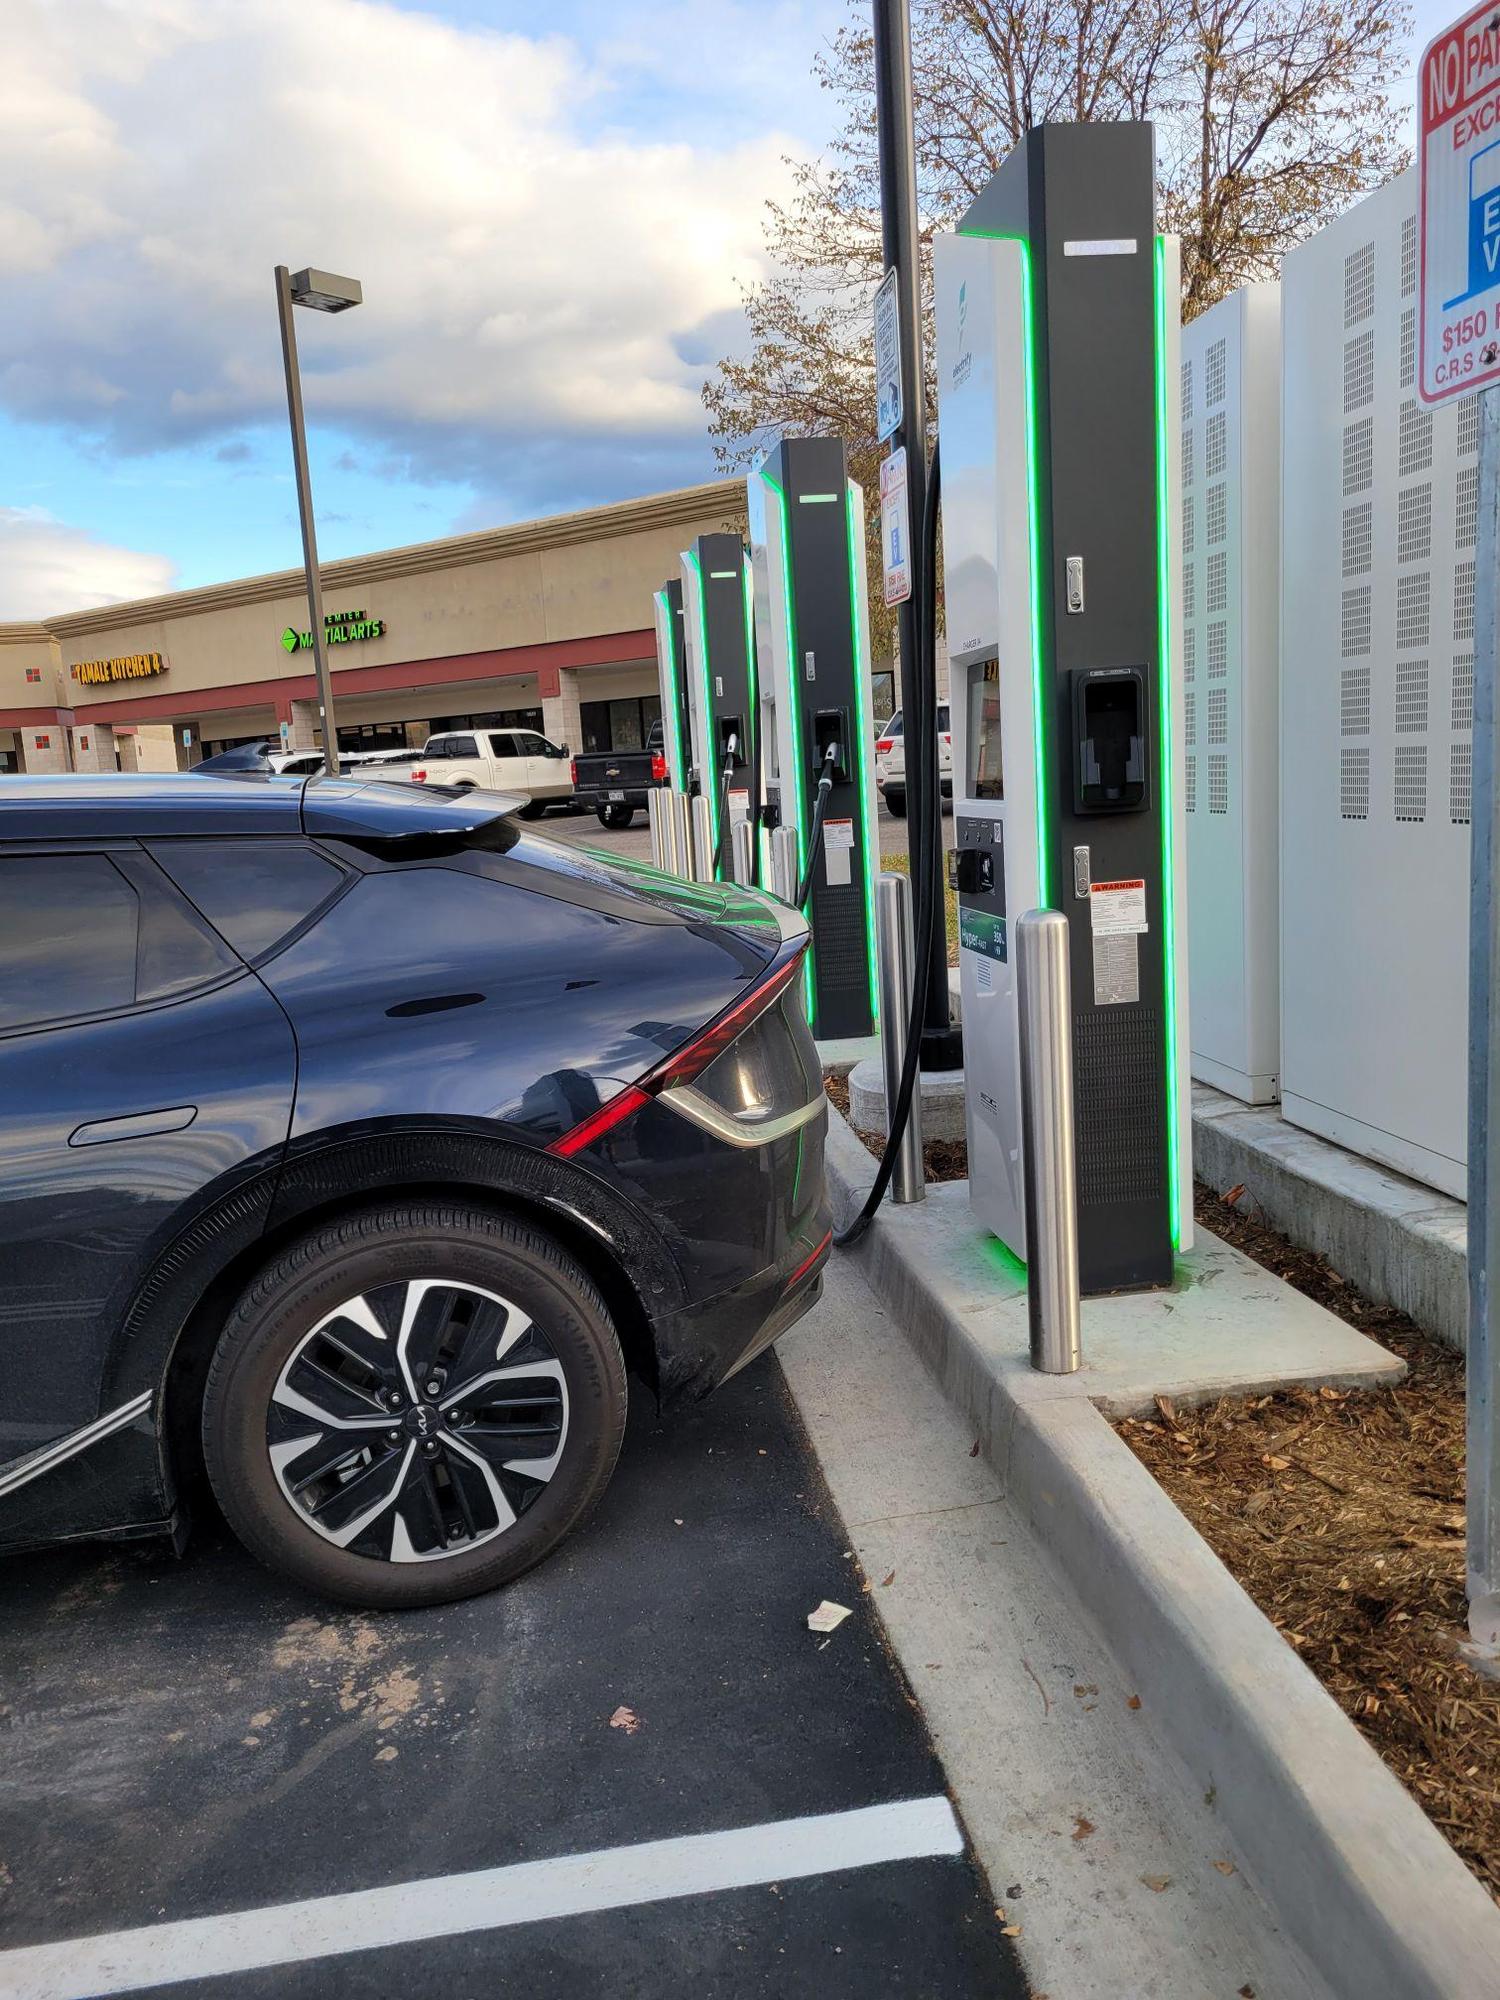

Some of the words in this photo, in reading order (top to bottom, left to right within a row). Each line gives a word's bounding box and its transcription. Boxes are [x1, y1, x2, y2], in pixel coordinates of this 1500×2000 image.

[1429, 40, 1460, 121] NO
[1443, 310, 1487, 355] $150
[327, 610, 360, 623] EMIER
[299, 626, 348, 649] MATIAL
[350, 620, 380, 640] ARTS
[75, 661, 110, 684] TAMALE
[111, 654, 151, 680] KITCHEN
[1101, 881, 1141, 890] WARNING
